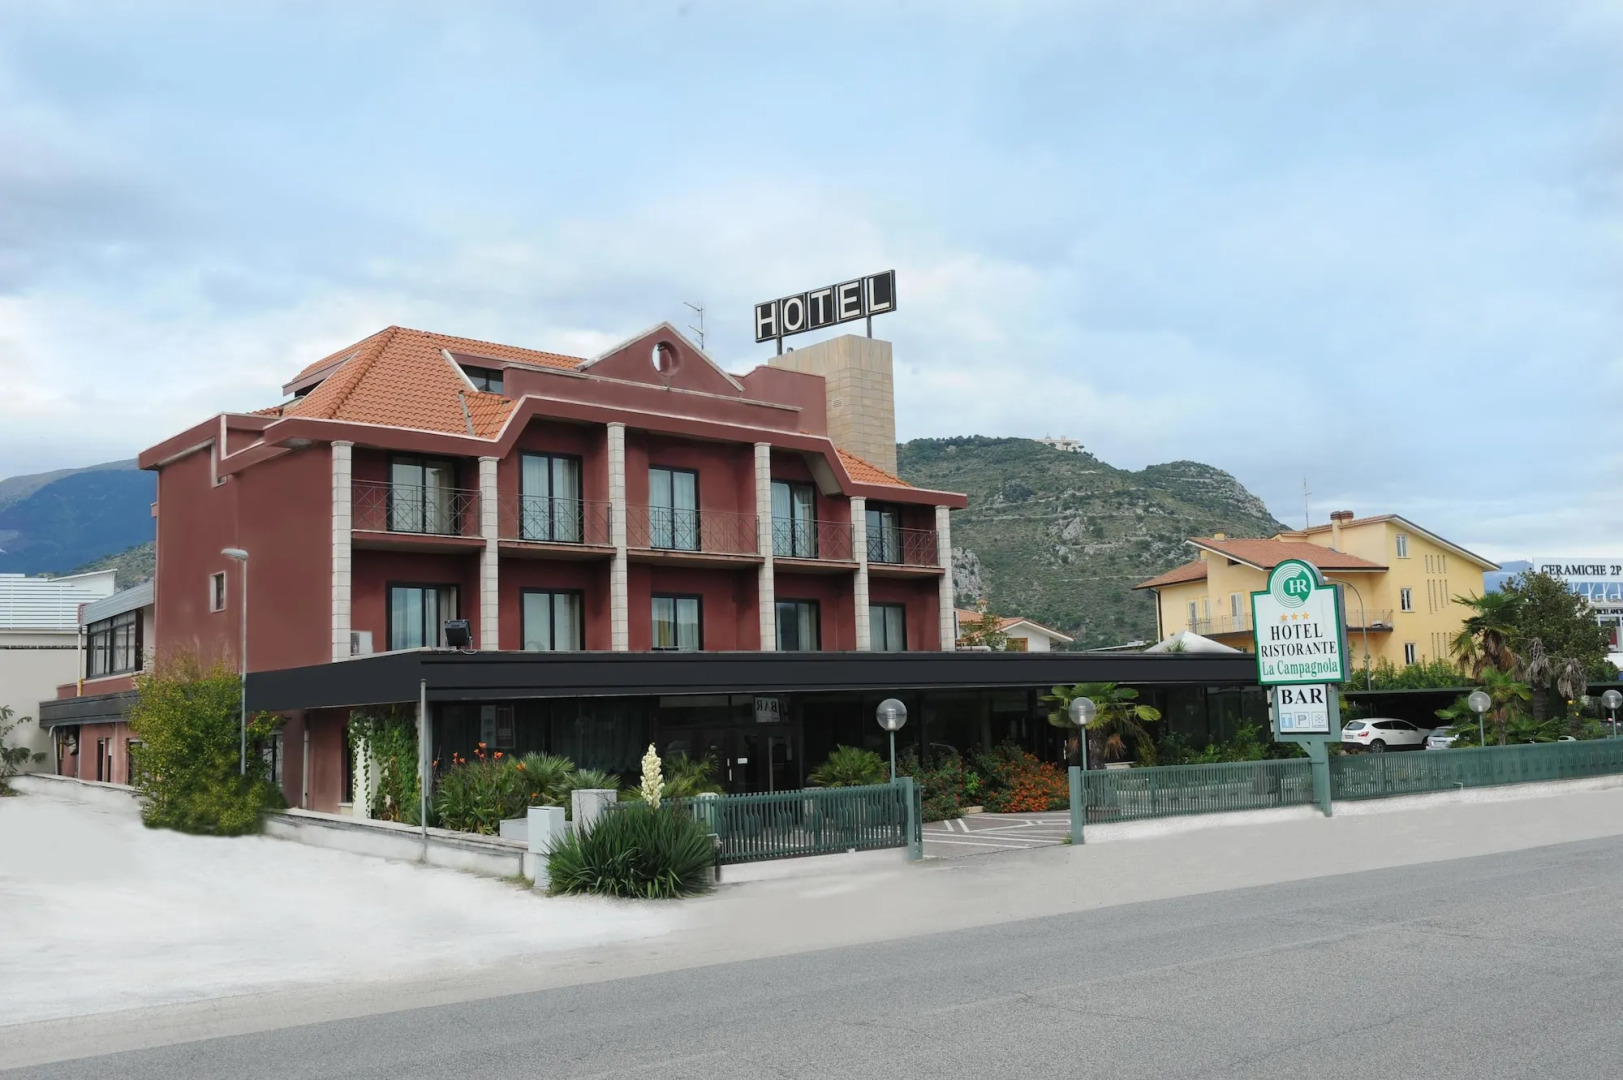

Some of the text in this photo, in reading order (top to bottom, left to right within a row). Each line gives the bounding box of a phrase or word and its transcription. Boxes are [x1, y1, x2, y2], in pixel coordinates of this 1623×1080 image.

[756, 277, 890, 339] HOTEL
[1541, 564, 1607, 576] CERAMICHE
[1288, 579, 1308, 594] HR
[1271, 623, 1323, 641] HOTEL
[1261, 641, 1337, 658] RISTORANTE
[1262, 658, 1338, 678] La Campagnola
[1281, 688, 1324, 705] BAR
[1298, 714, 1307, 726] P
